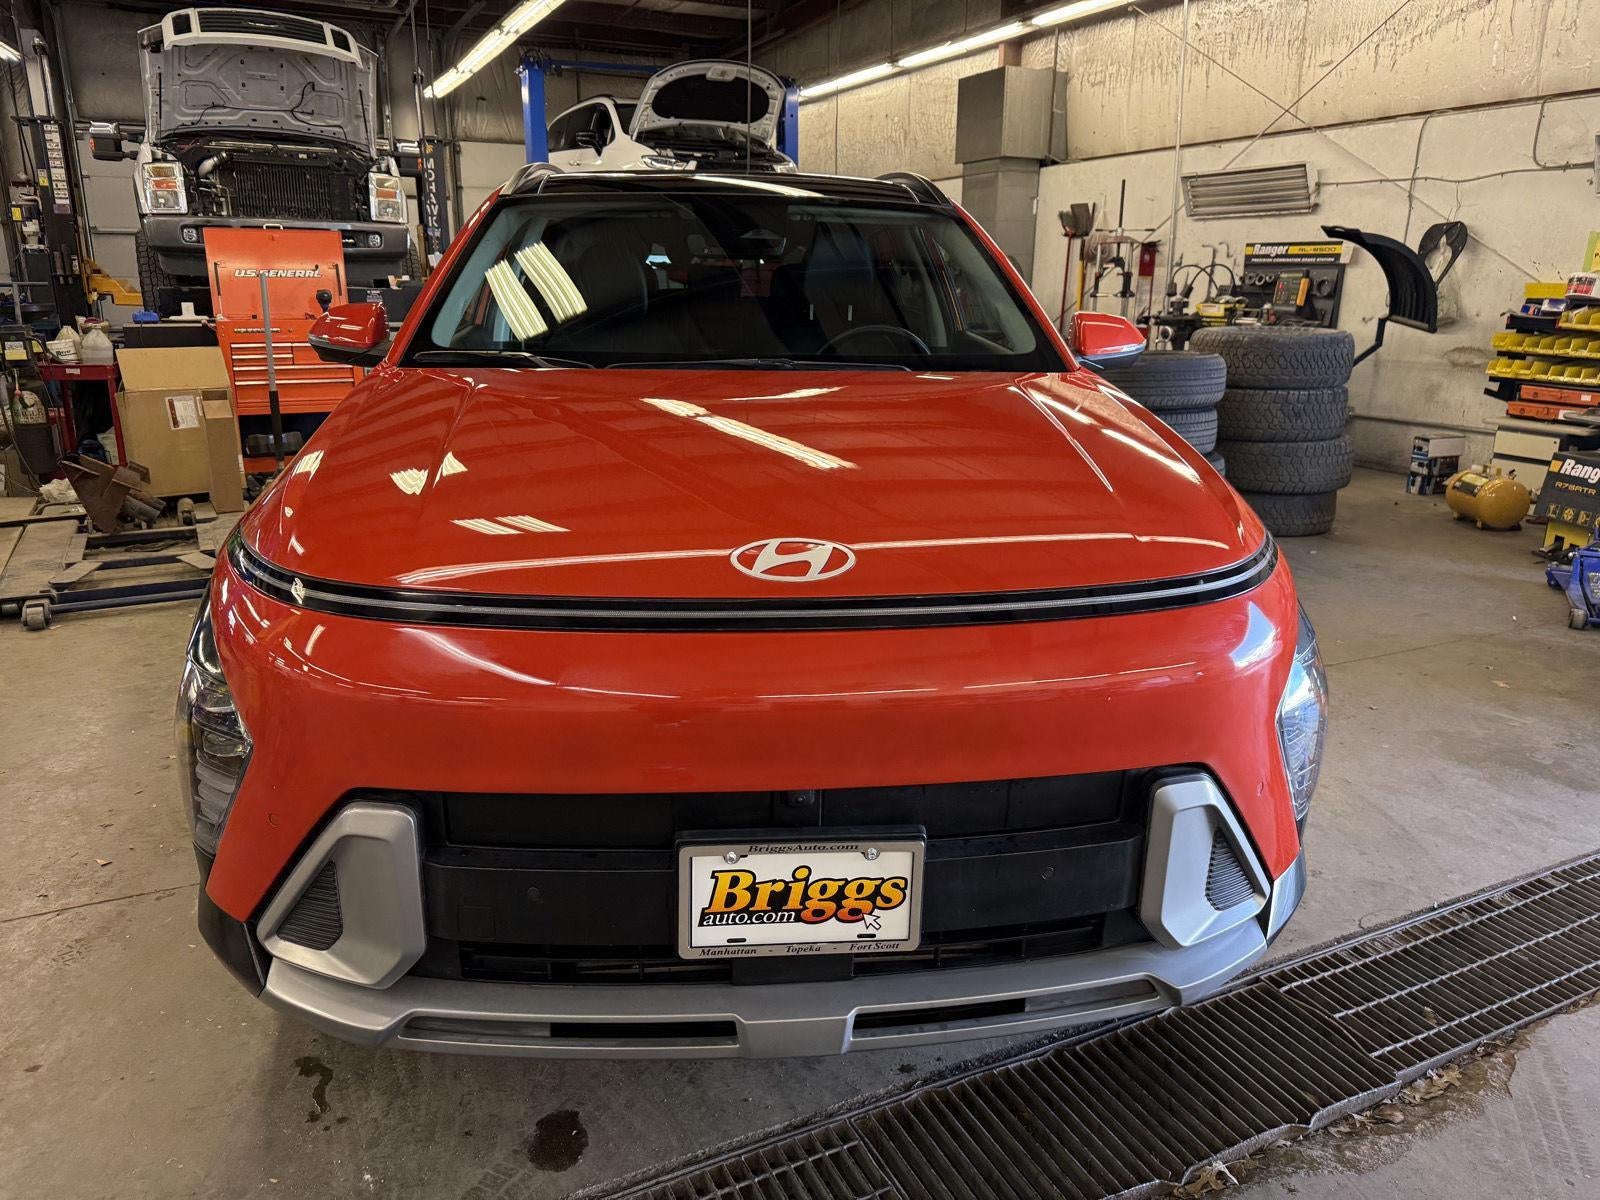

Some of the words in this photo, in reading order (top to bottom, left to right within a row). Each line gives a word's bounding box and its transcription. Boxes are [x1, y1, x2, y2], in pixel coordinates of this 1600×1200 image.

[423, 158, 439, 227] MOHAWK
[1252, 244, 1288, 256] Ranger
[748, 844, 859, 854] BriggsAuto.com
[702, 866, 907, 923] Briggs
[703, 911, 795, 926] auto.com
[700, 948, 757, 956] Manhattan
[785, 945, 821, 953] Topeka
[849, 943, 872, 951] Fort
[873, 942, 900, 950] Scott
